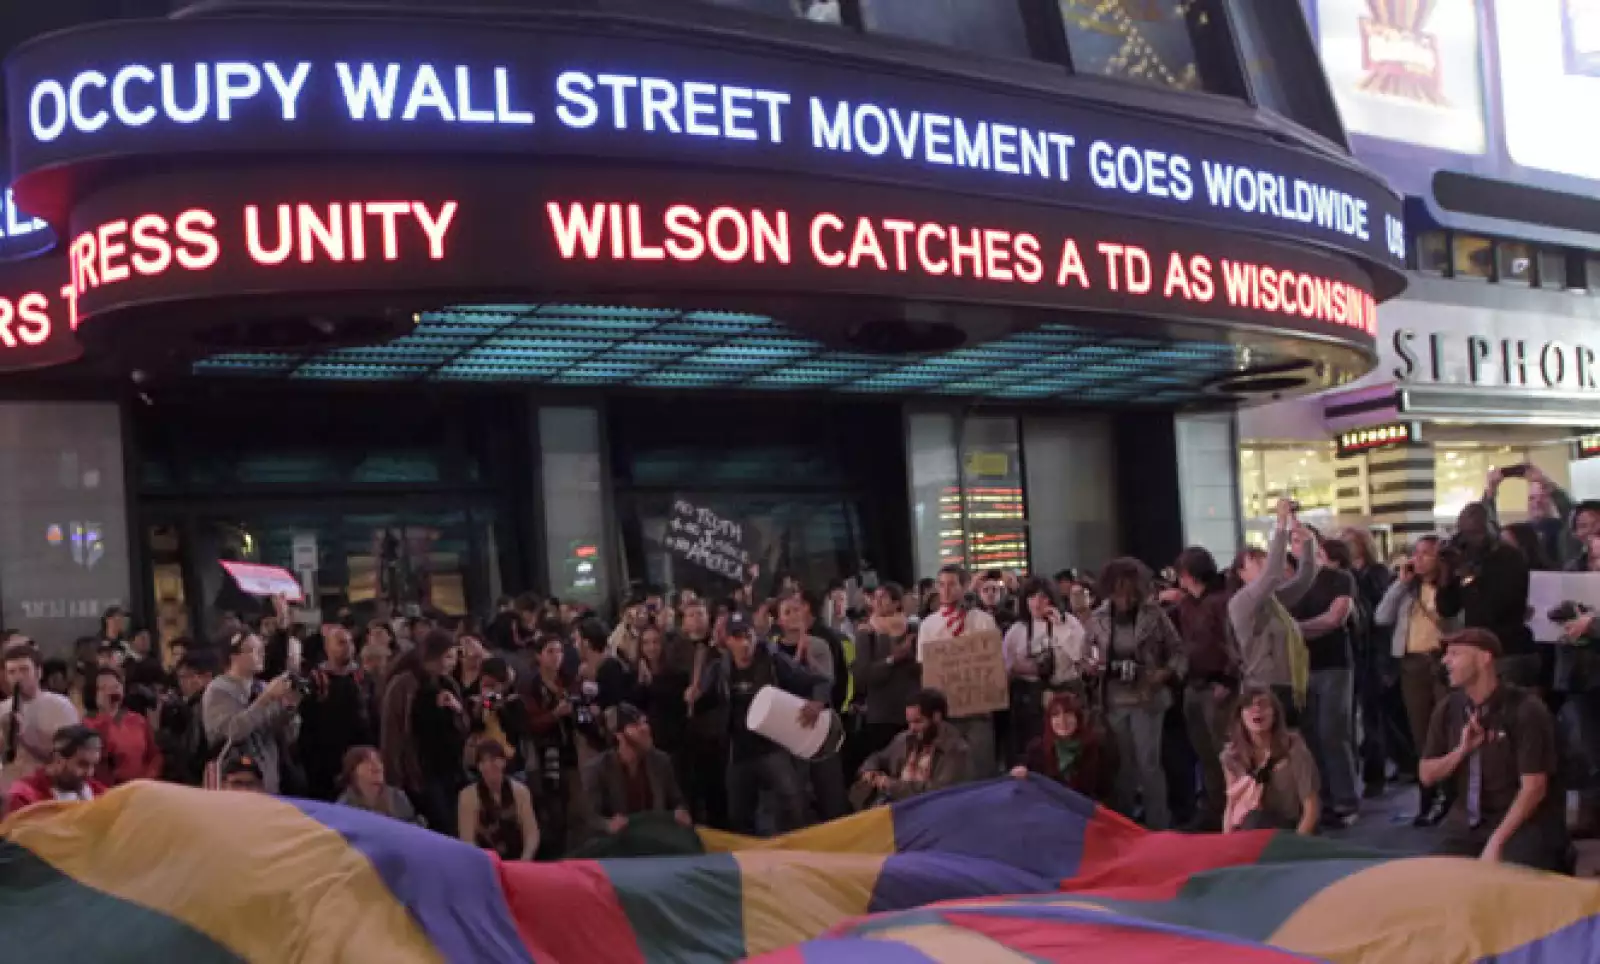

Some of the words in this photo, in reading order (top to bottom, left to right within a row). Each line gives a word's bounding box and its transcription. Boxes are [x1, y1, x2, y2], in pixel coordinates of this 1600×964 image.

[29, 62, 311, 140] OCCUPY
[335, 62, 535, 124] WALL
[555, 72, 791, 143] STREET
[809, 96, 1076, 182] MOVEMENT
[1088, 139, 1194, 201] GOES
[1202, 160, 1371, 241] WORLDWIDE
[245, 201, 457, 264] UNITY
[546, 202, 789, 264] WILSON
[811, 213, 1043, 283] CATCHES
[1057, 239, 1090, 288] A
[1098, 242, 1152, 295] TD
[1163, 252, 1215, 302] AS
[1221, 258, 1365, 330] WISCONSIN
